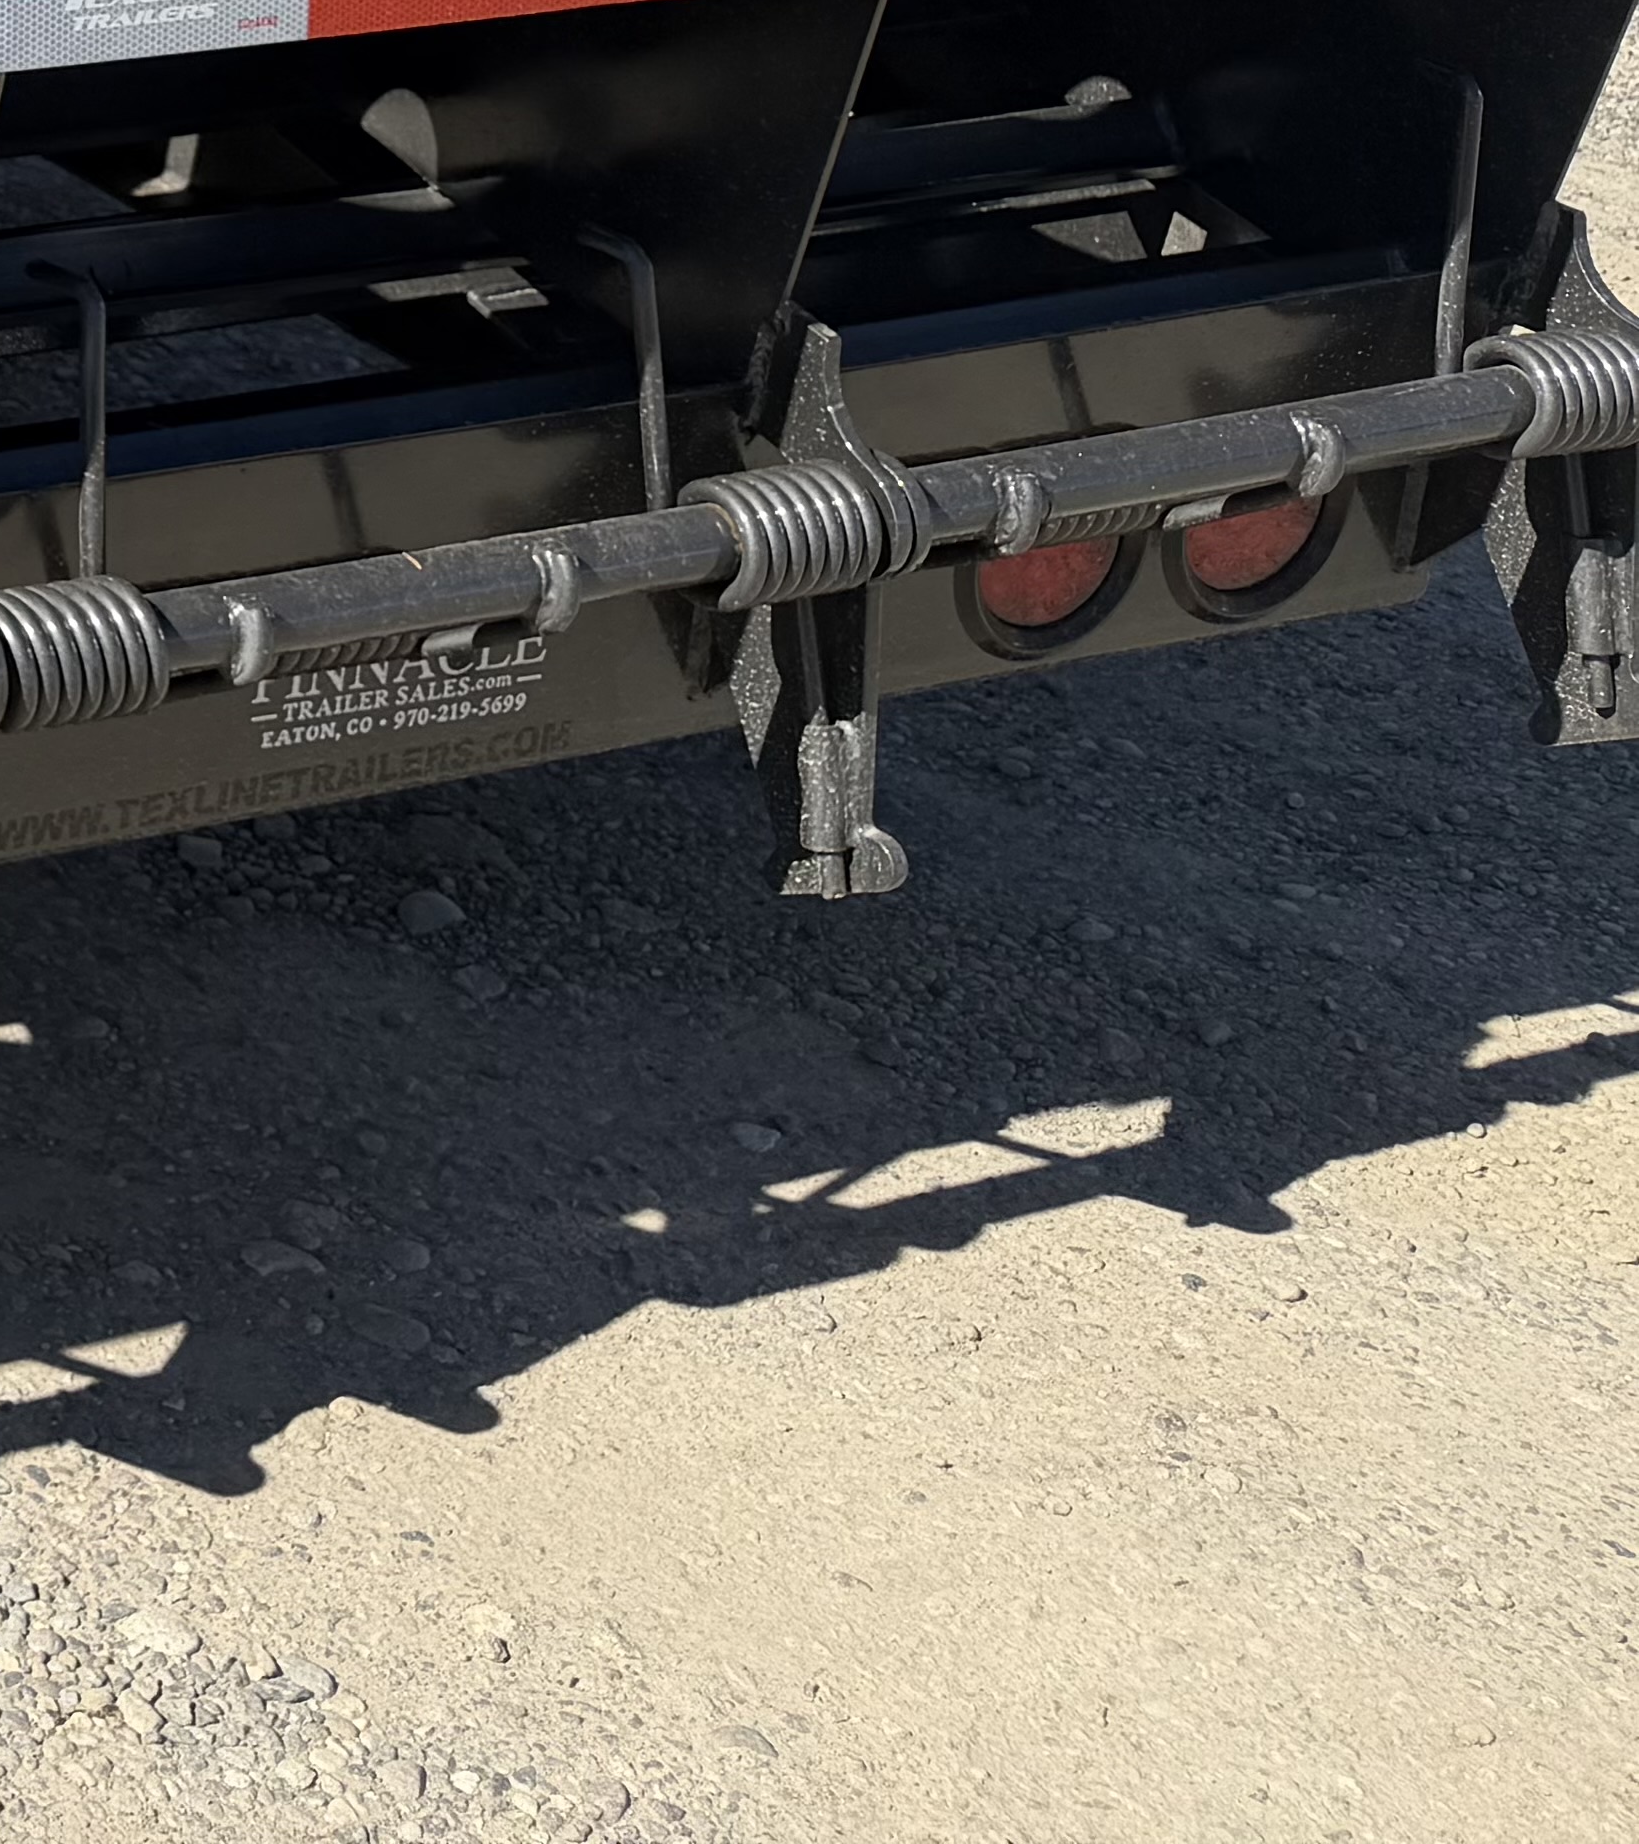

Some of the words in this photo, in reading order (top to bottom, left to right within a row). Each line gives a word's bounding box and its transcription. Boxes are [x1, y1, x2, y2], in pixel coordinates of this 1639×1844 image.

[72, 2, 219, 31] TRAILERS
[261, 721, 342, 749] EATON,
[346, 716, 373, 736] CO
[393, 692, 528, 731] 970-219-5699
[282, 689, 389, 723] TRAILER
[395, 673, 512, 707] SALES.com
